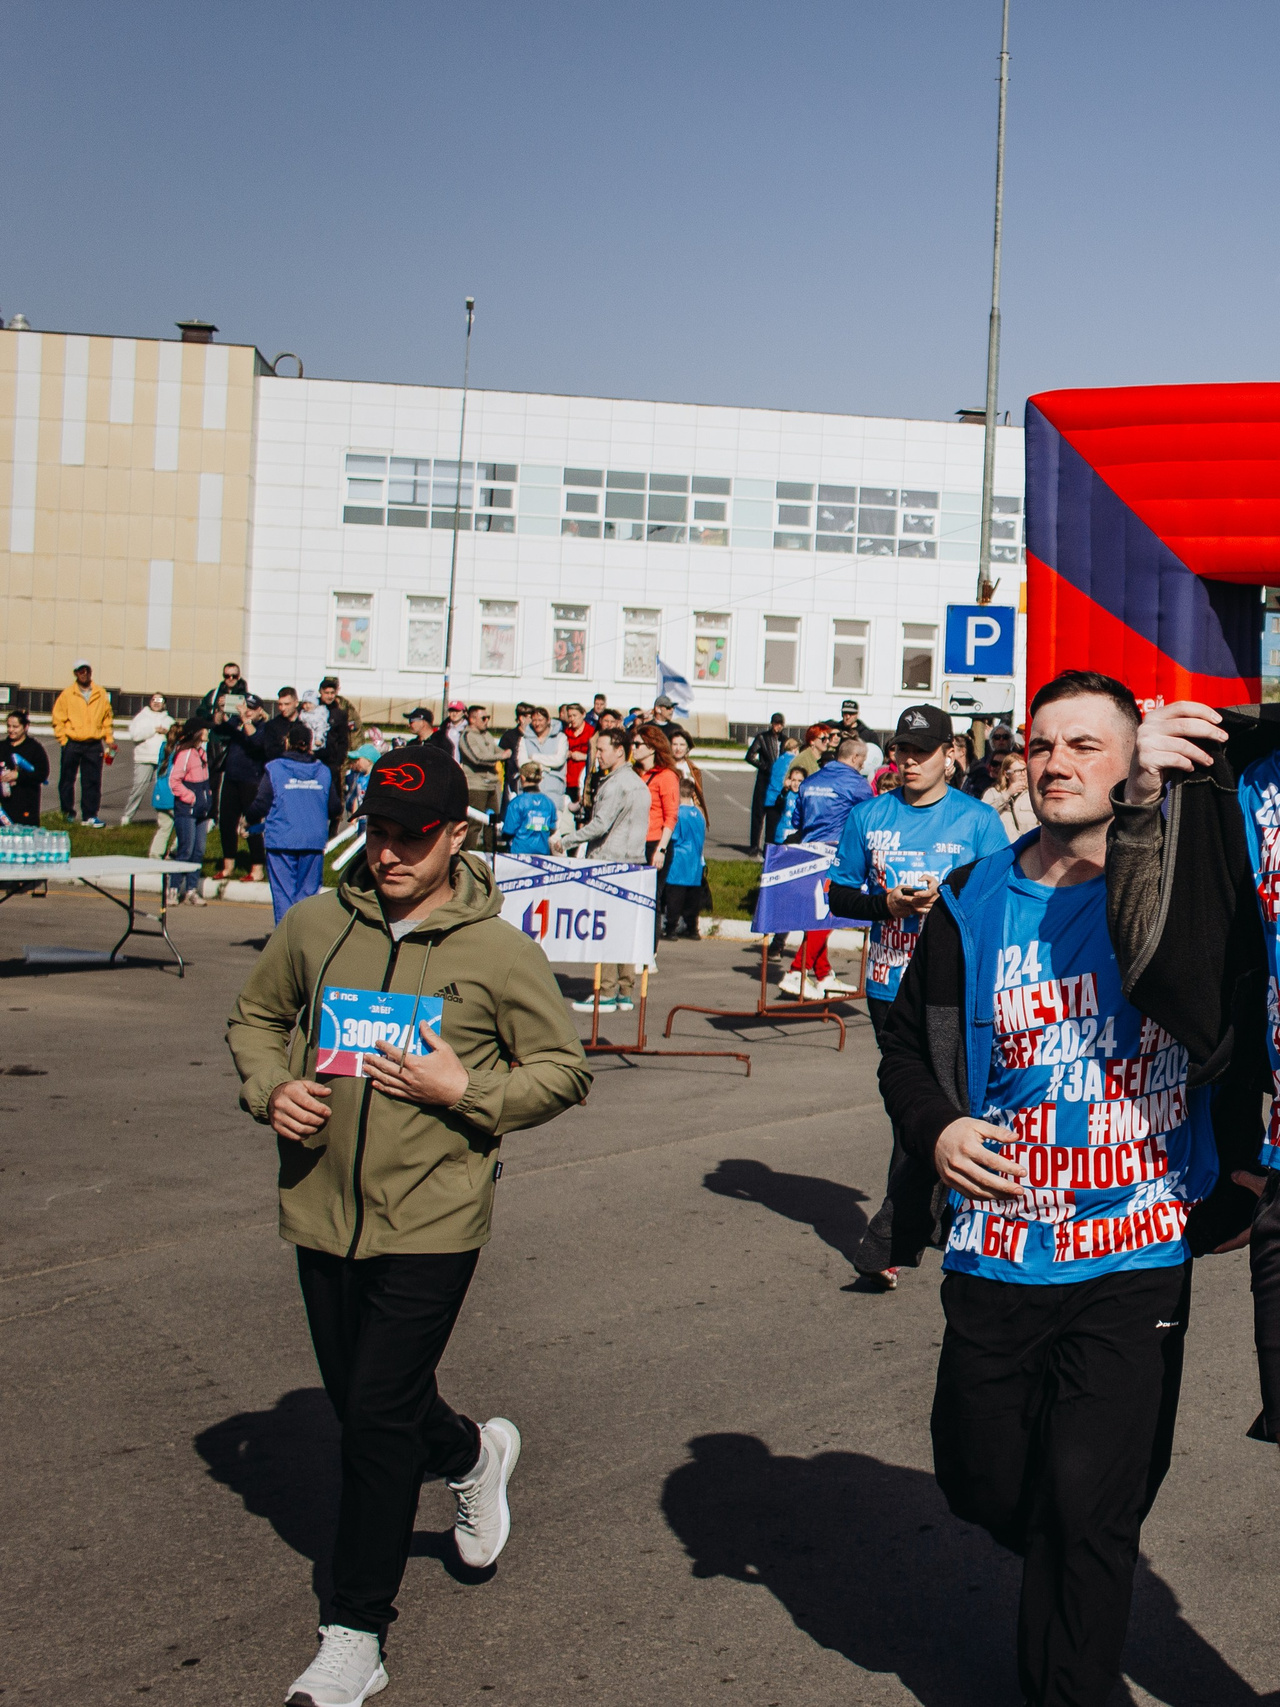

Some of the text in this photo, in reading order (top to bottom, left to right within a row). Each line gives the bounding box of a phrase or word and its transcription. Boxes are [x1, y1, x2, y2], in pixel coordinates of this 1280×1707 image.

[965, 616, 1002, 666] P
[866, 830, 901, 851] 2024
[555, 907, 608, 941] ПСБ
[340, 993, 359, 1002] ПСБ
[994, 972, 1099, 1034] #МЕЧТА
[342, 1018, 417, 1053] 30024
